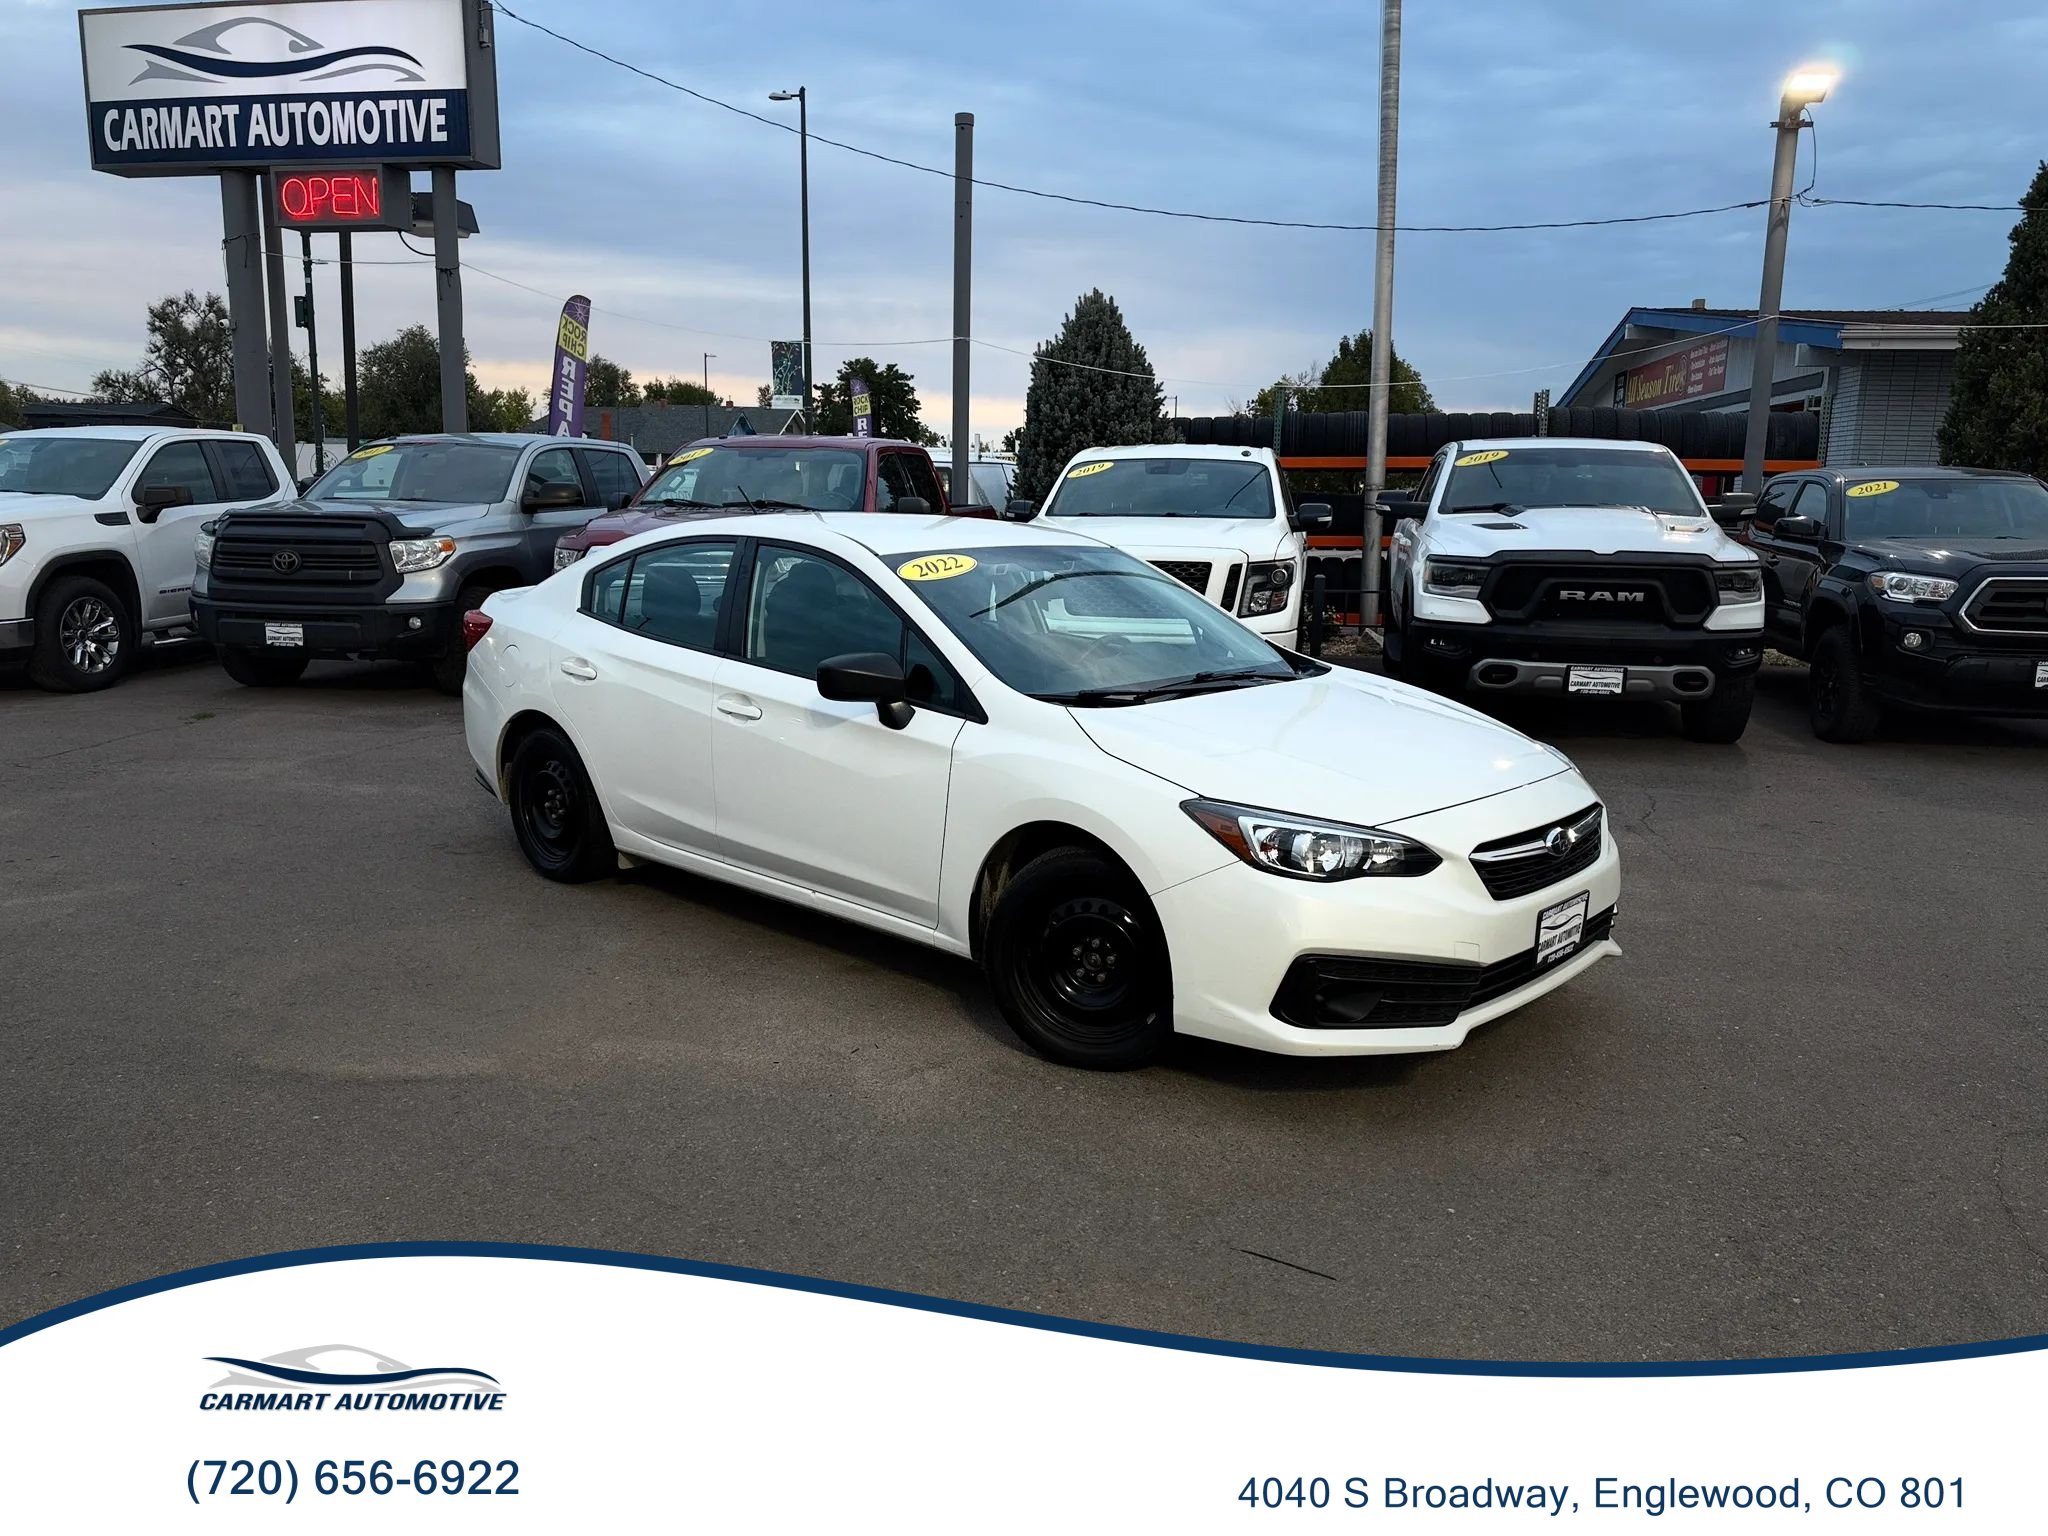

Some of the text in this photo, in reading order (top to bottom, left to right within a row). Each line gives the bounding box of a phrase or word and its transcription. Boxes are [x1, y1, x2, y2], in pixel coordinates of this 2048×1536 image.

[104, 99, 448, 151] CARMART AUTOMOTIVE
[282, 177, 380, 217] OPEN
[1636, 375, 1662, 401] Season
[853, 395, 869, 405] ROCK
[854, 405, 868, 415] CHIP
[1465, 452, 1499, 464] 2019
[1076, 464, 1105, 476] 2019
[1857, 483, 1887, 495] 2021
[912, 556, 963, 577] 2022
[1560, 590, 1644, 601] RAM
[1543, 904, 1564, 918] CARMART
[1538, 922, 1582, 953] CARMART AUTOMOTIVE
